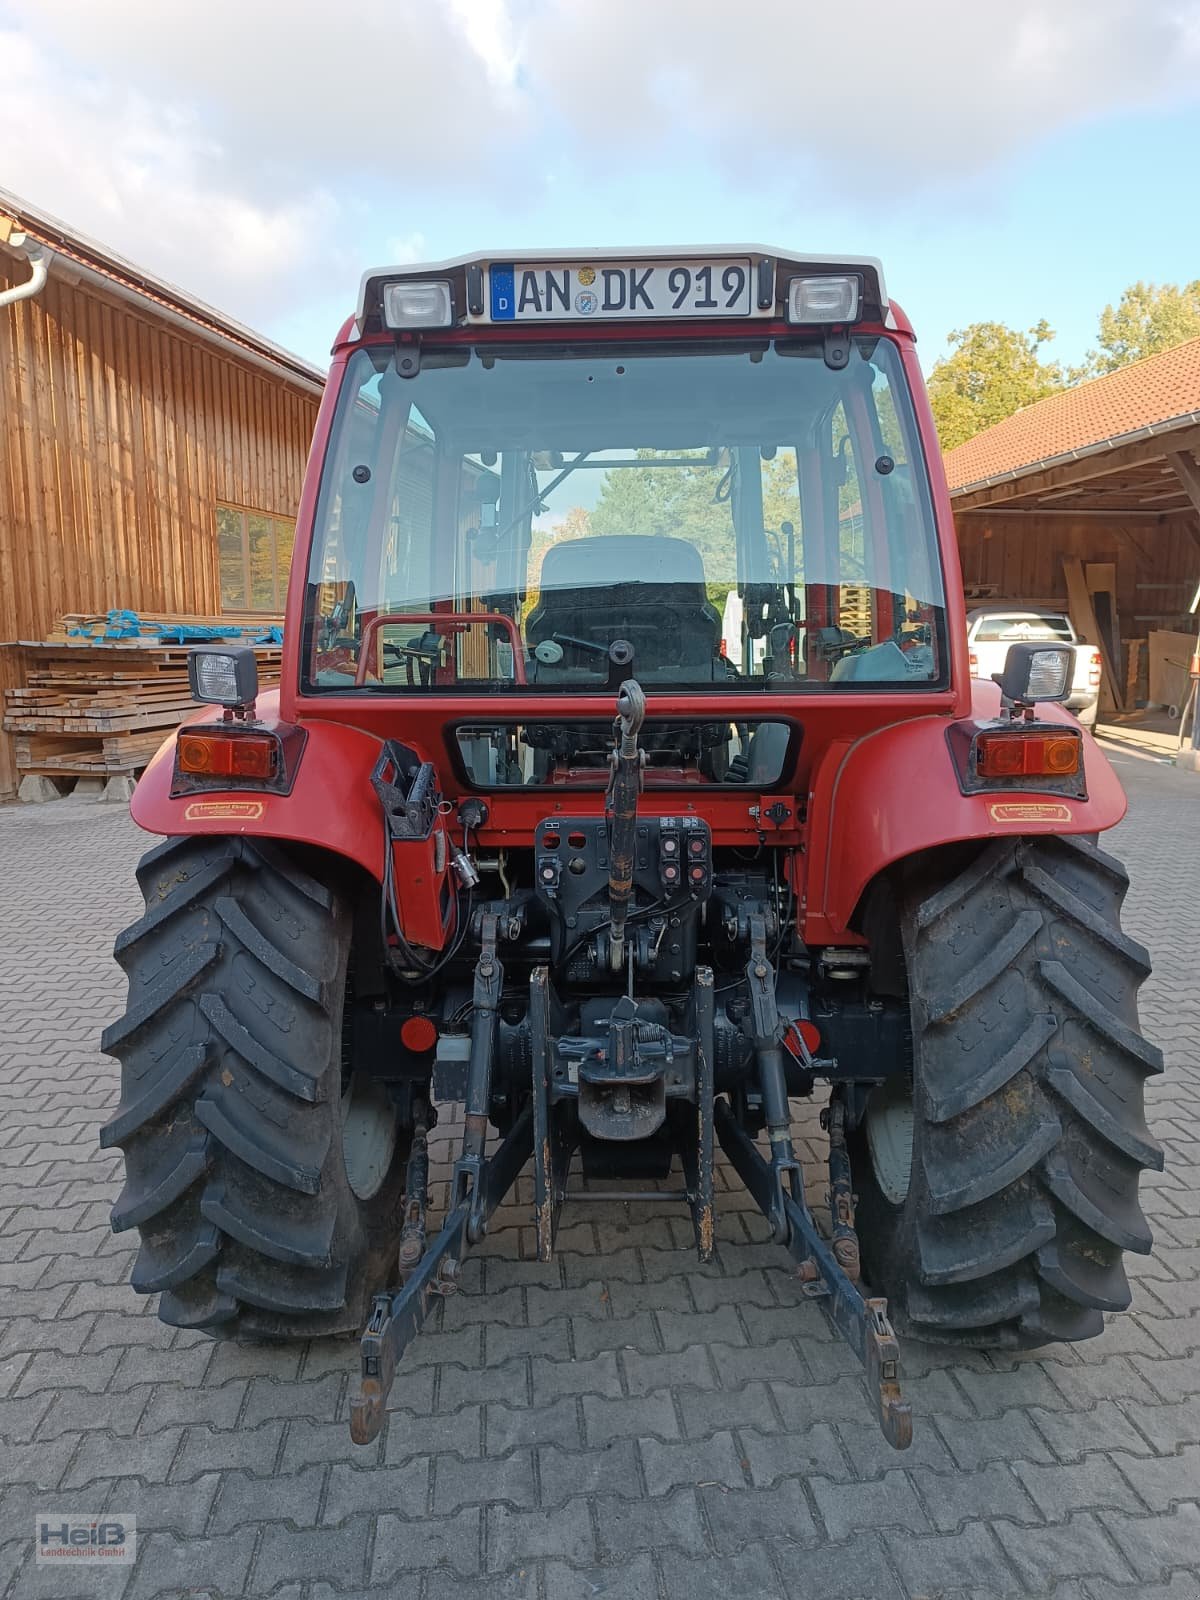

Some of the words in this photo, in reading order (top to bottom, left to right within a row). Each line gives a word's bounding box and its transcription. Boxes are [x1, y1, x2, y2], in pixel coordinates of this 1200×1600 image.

[498, 297, 508, 310] D
[517, 270, 571, 313] AN
[601, 267, 655, 311] DK
[668, 265, 746, 310] 919
